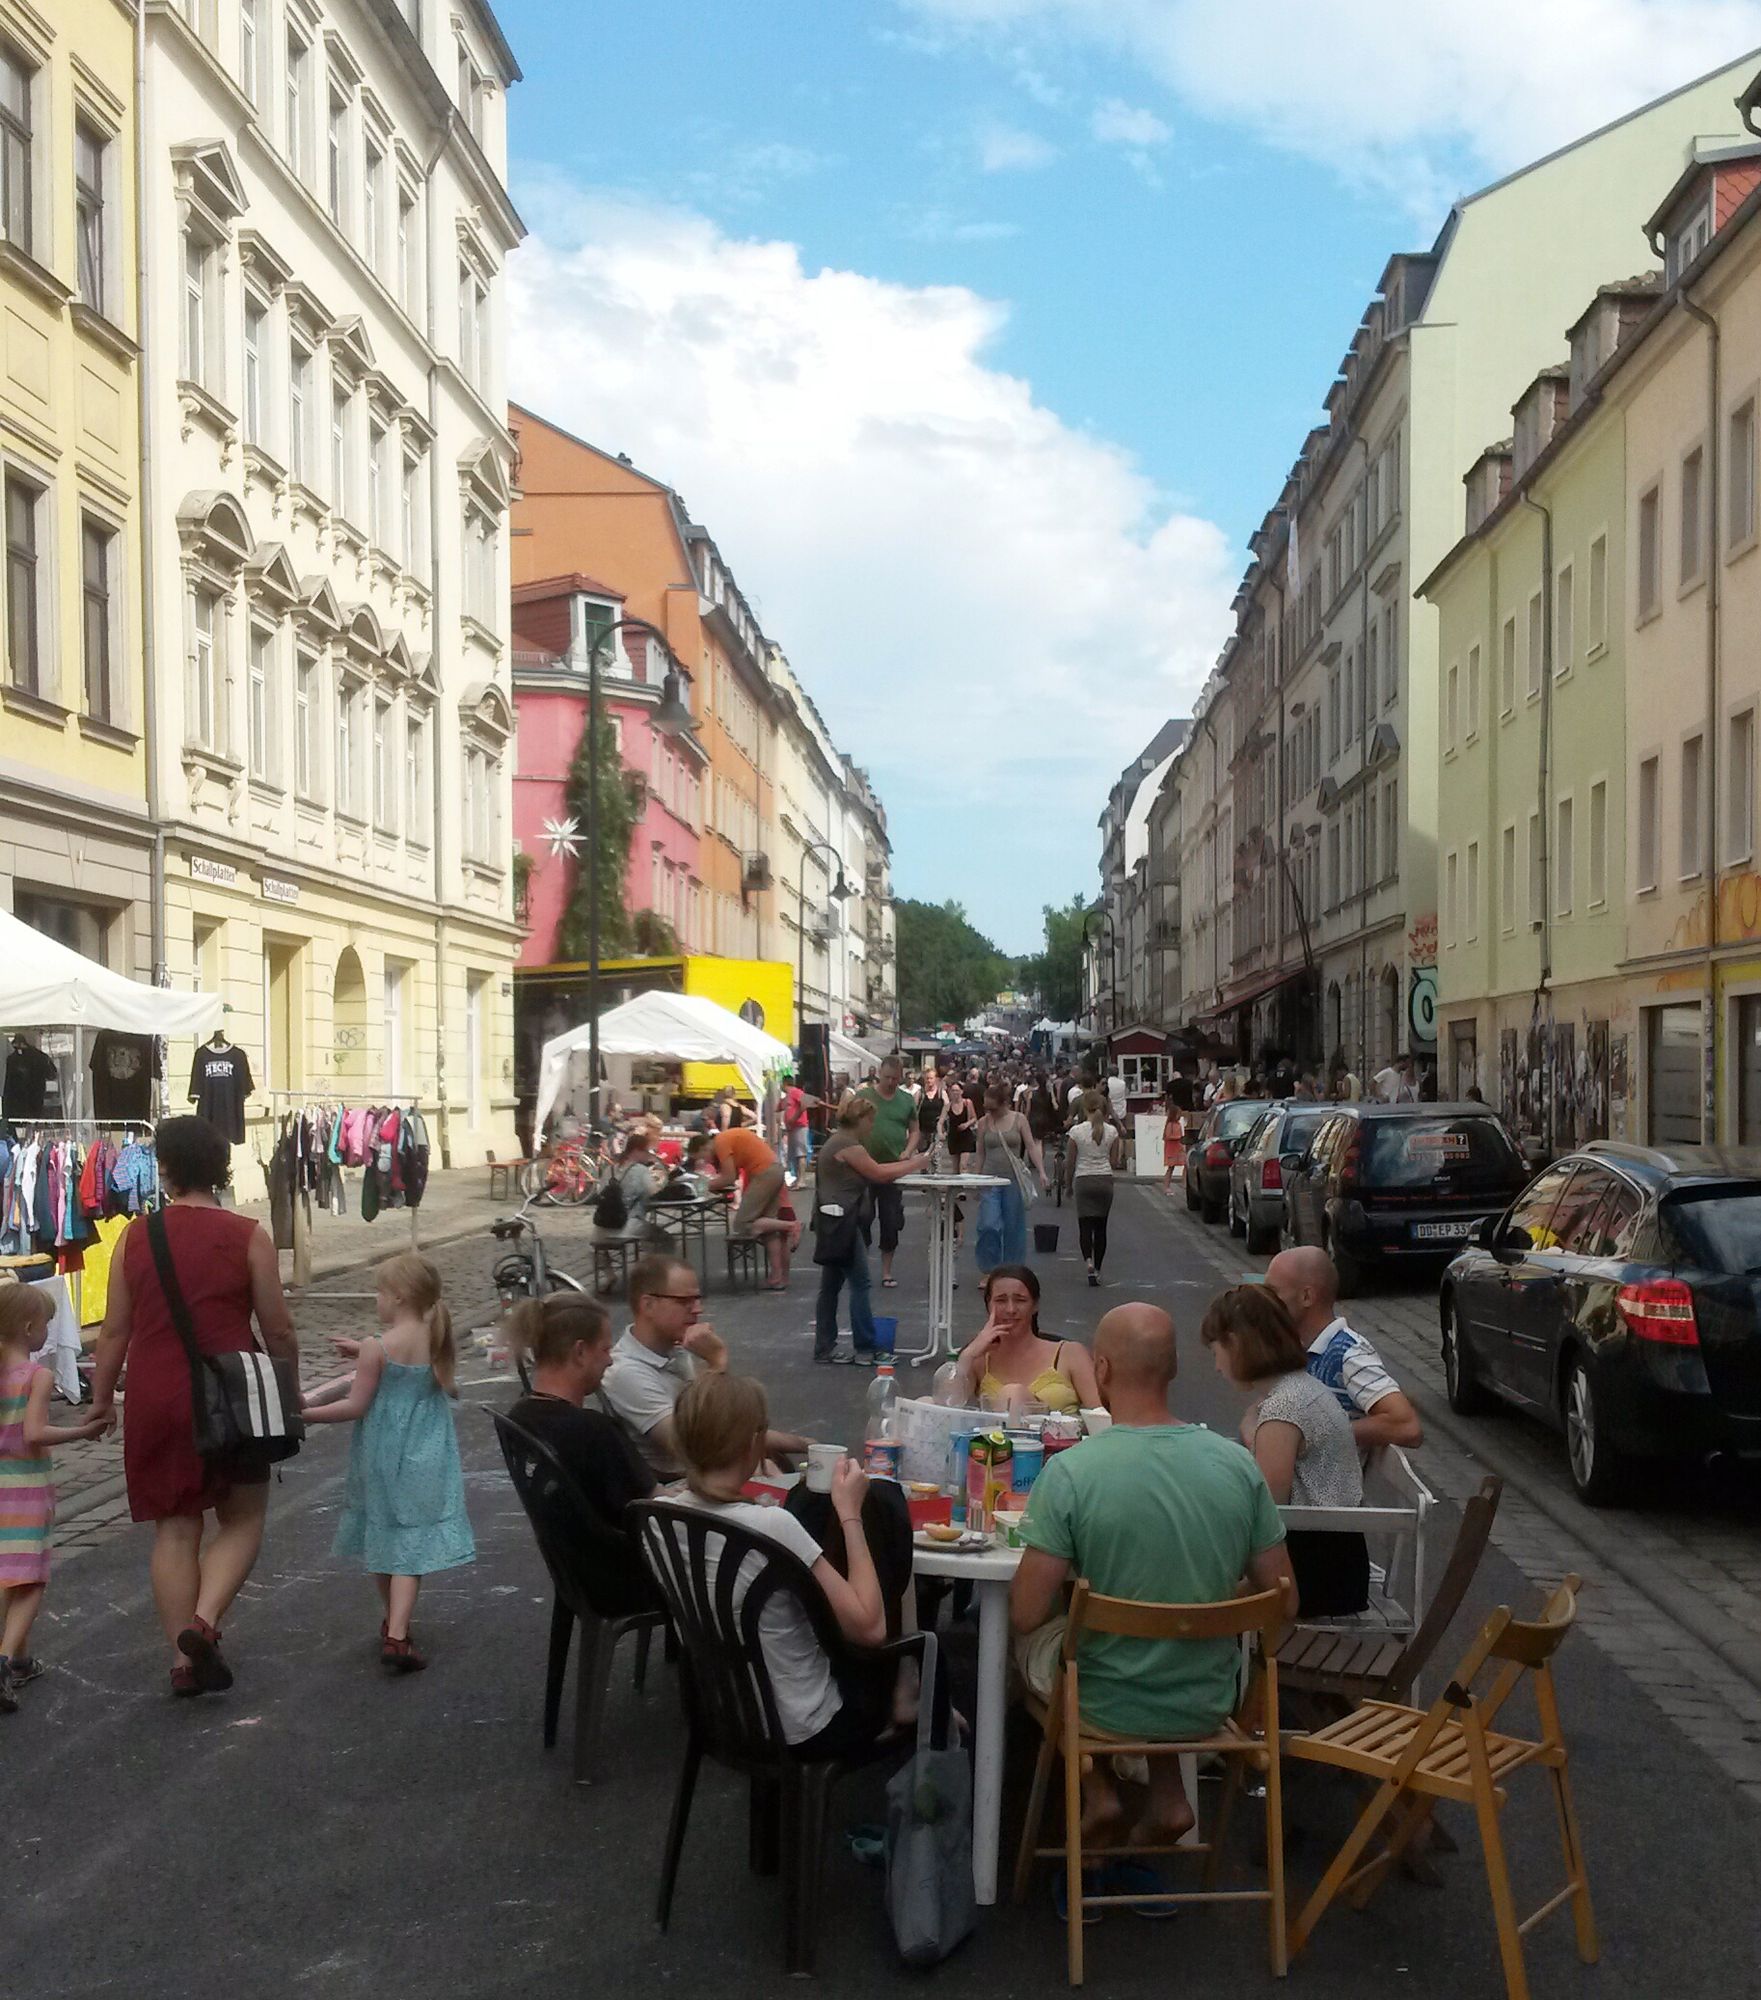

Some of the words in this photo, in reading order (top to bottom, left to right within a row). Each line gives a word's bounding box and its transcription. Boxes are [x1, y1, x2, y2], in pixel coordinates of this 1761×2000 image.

[193, 858, 235, 882] Schallplatten
[205, 1062, 234, 1077] HECHT
[1419, 1225, 1433, 1237] DD
[1439, 1224, 1452, 1236] EP
[1454, 1223, 1470, 1235] 33
